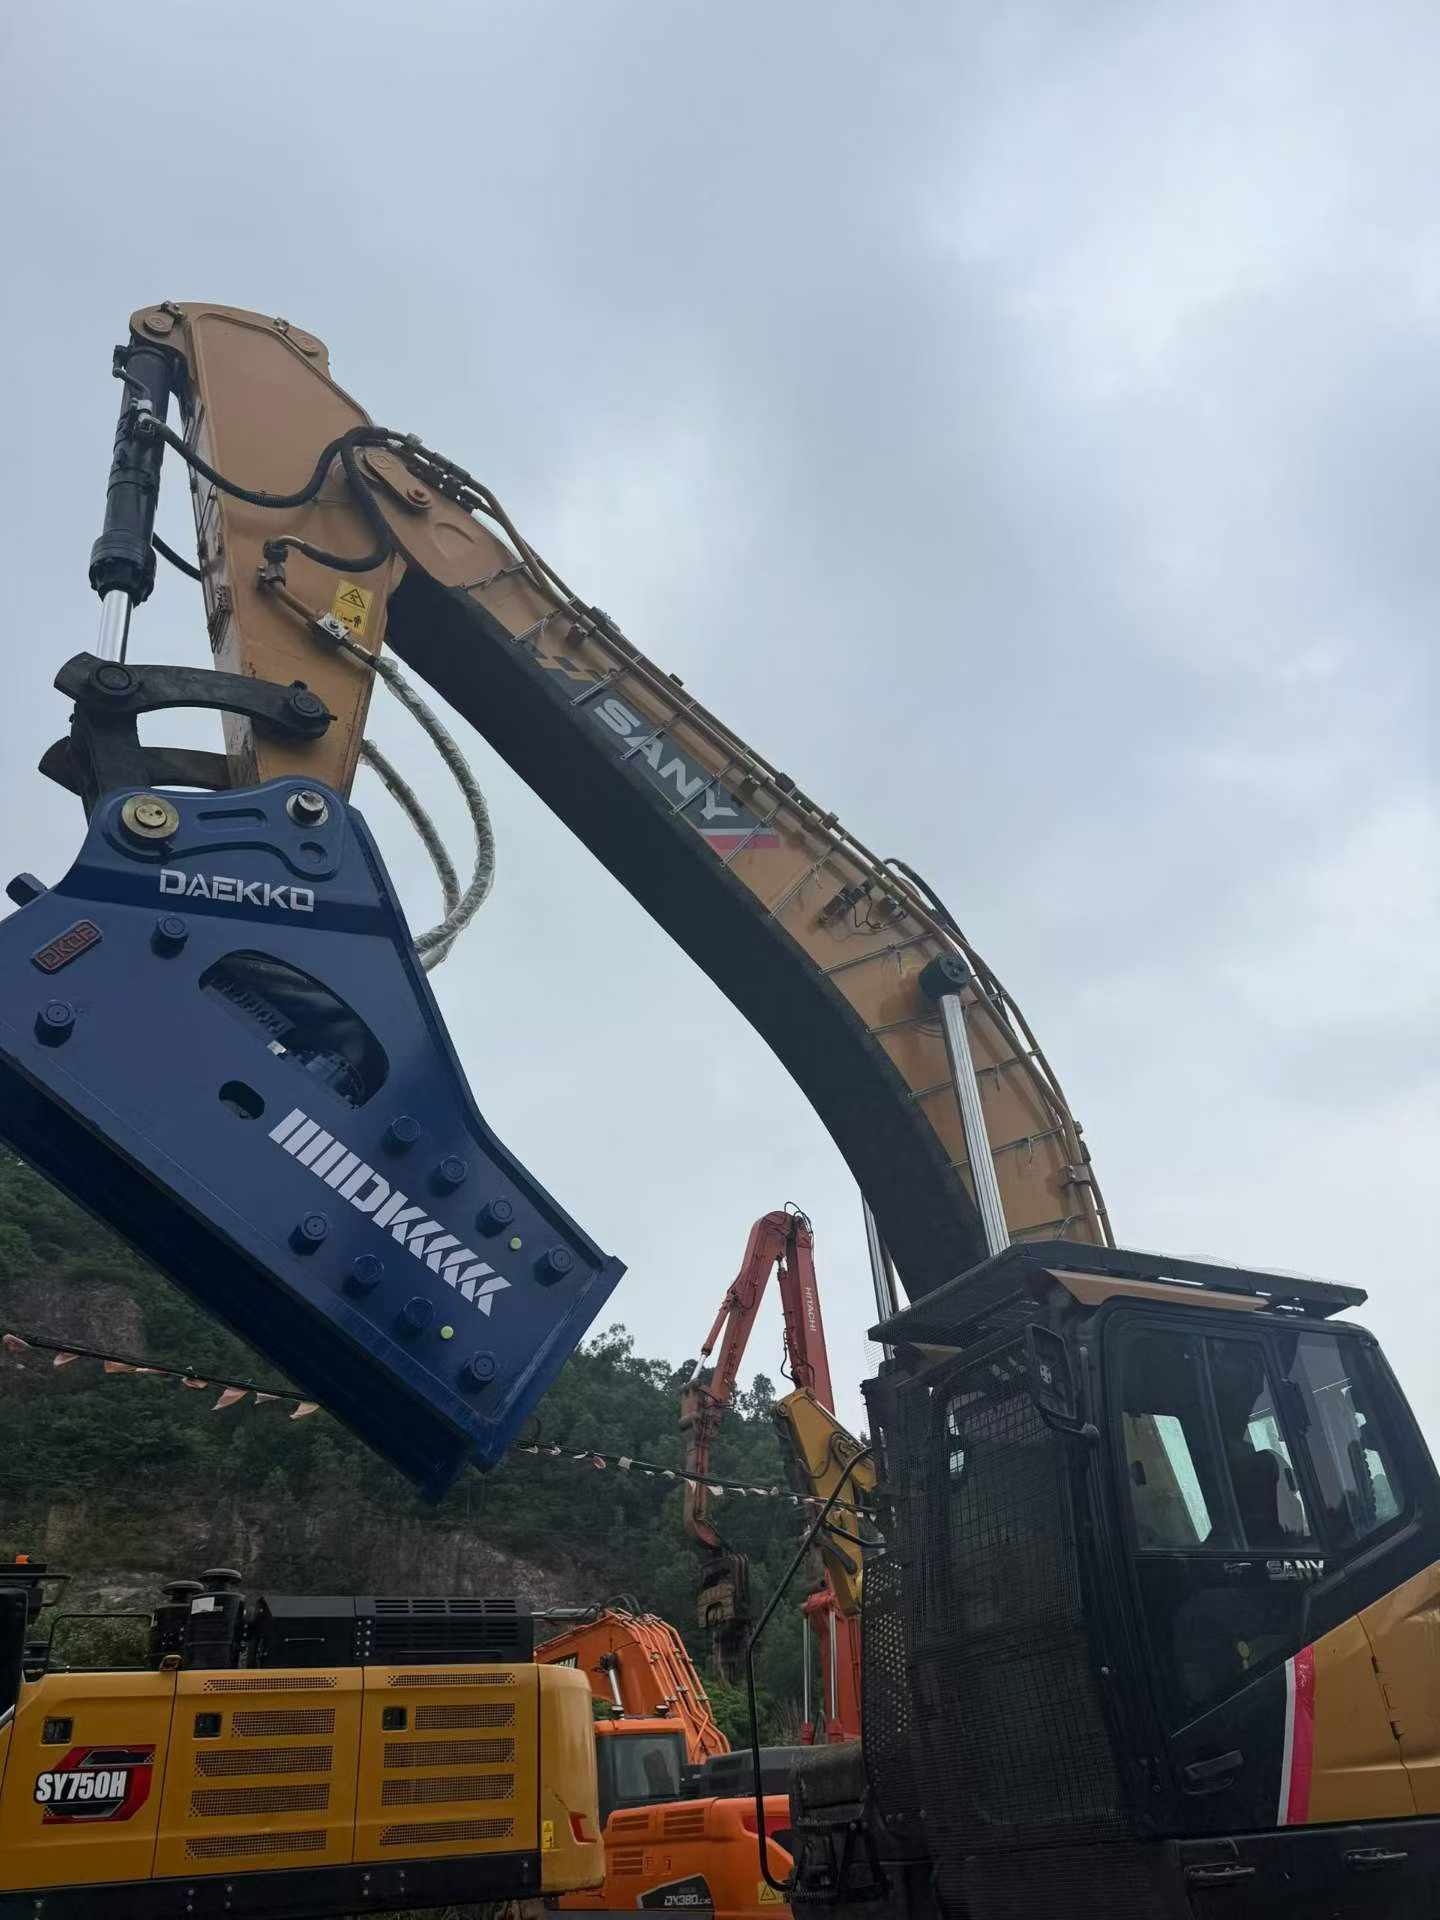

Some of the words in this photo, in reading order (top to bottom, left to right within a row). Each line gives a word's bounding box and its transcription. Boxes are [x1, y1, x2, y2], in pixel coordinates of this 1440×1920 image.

[594, 699, 738, 820] SANY
[160, 868, 315, 912] DAEKKO
[804, 1287, 817, 1331] HITACHI
[36, 1771, 127, 1802] SY750H
